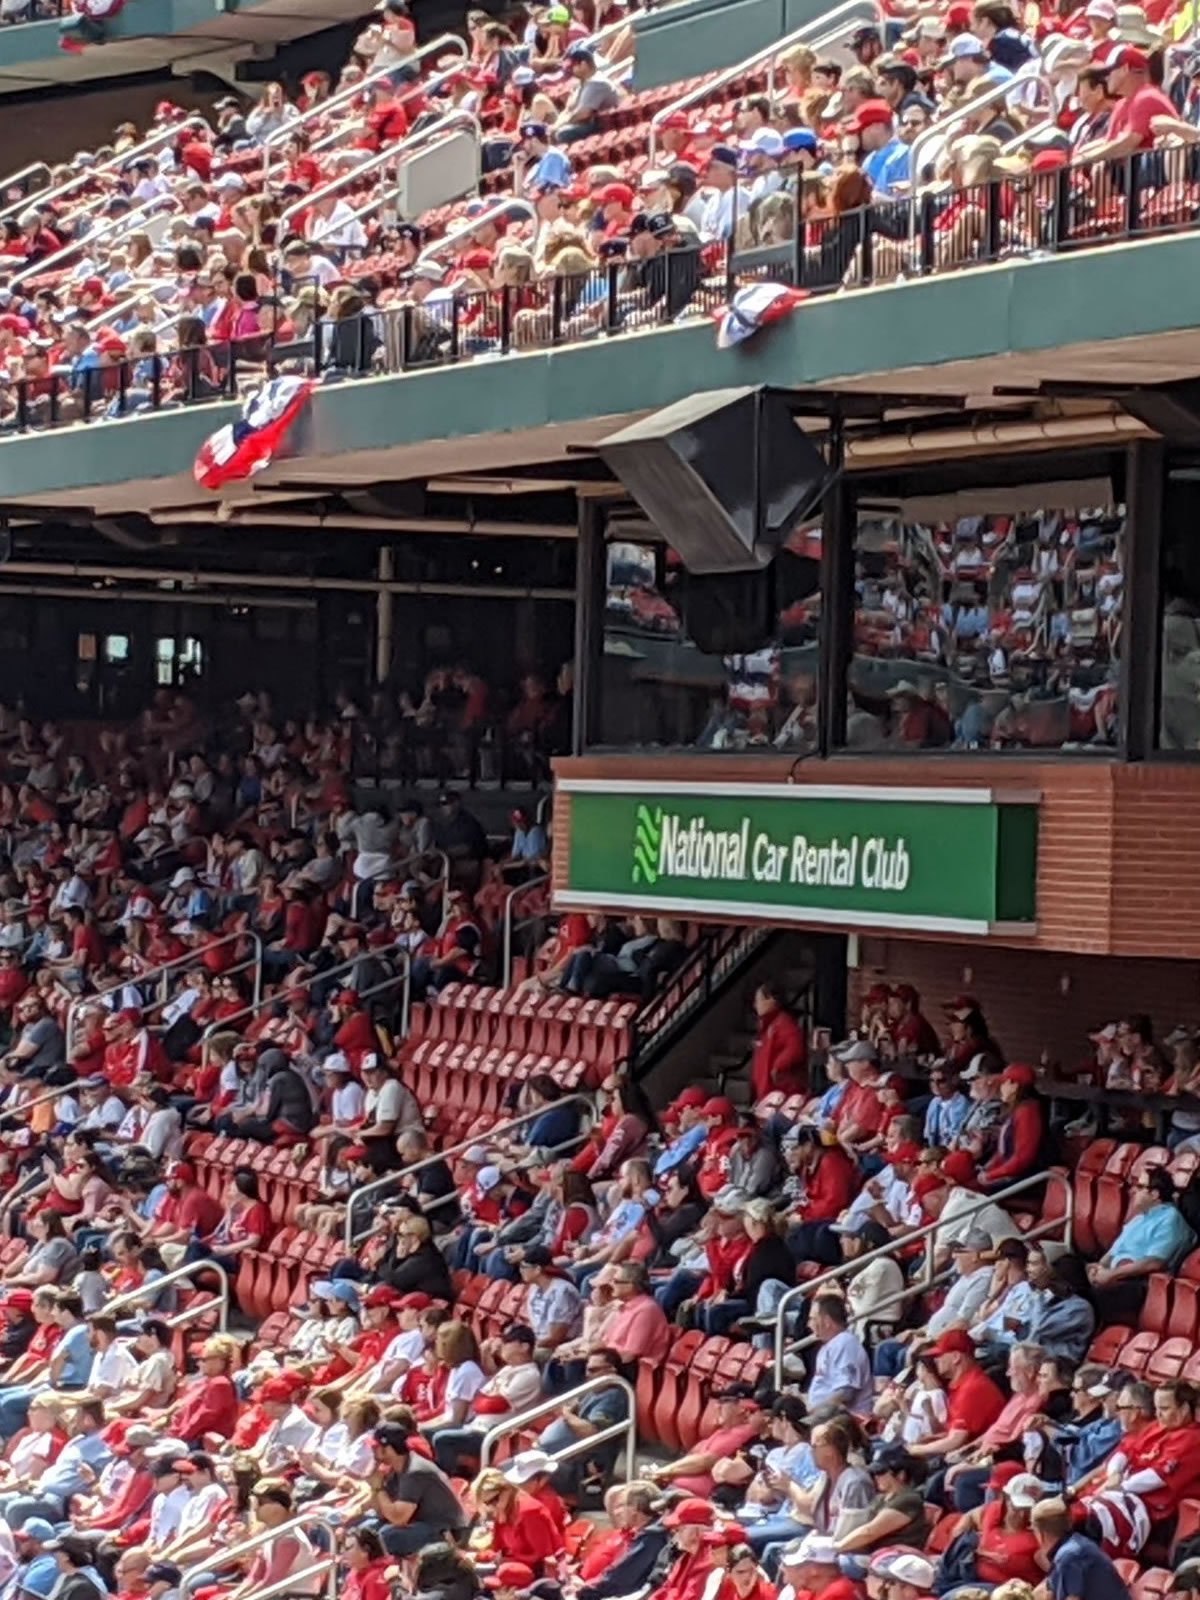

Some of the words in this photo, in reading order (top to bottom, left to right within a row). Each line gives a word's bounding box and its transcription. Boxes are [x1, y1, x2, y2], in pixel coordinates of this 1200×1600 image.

[658, 814, 750, 881] National
[752, 834, 787, 883] Car
[790, 834, 858, 886] Rental
[861, 837, 909, 890] Club
